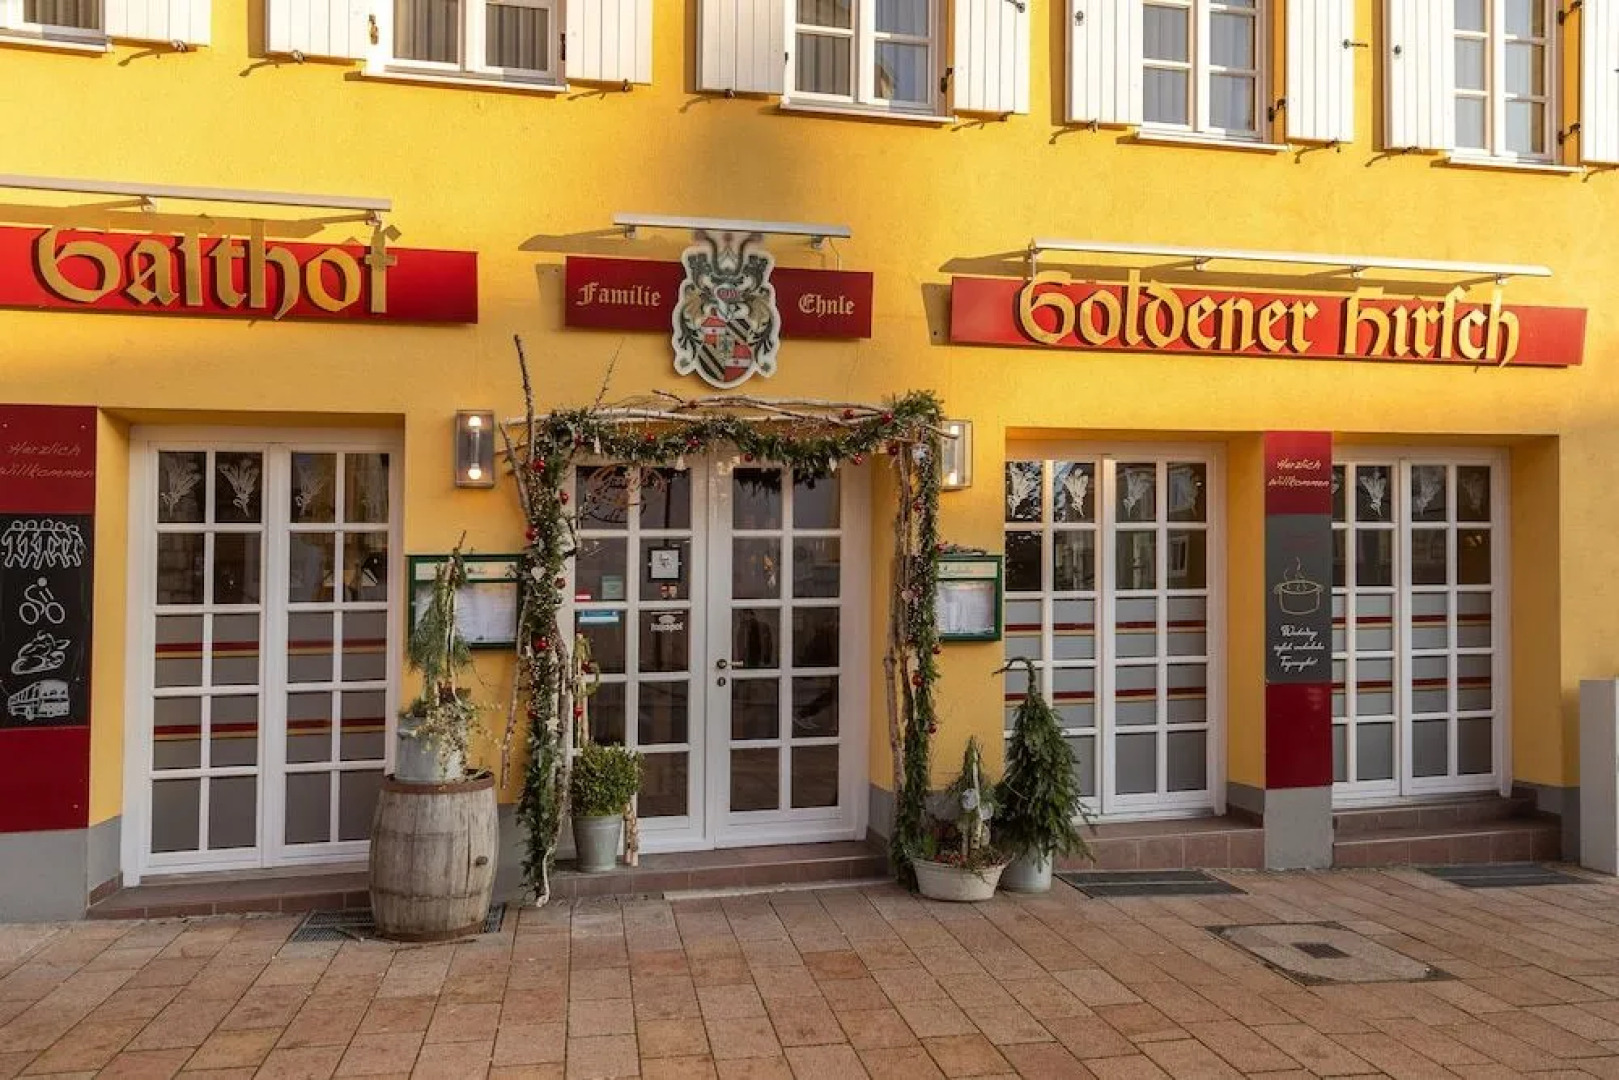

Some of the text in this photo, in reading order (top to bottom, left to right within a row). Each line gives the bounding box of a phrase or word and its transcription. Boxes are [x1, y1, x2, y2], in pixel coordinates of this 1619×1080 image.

[576, 283, 856, 316] Familie Ehnle
[1020, 268, 1520, 367] Goldener Hirsch
[8, 440, 80, 456] Herzlich
[1276, 458, 1321, 470] Herzlich
